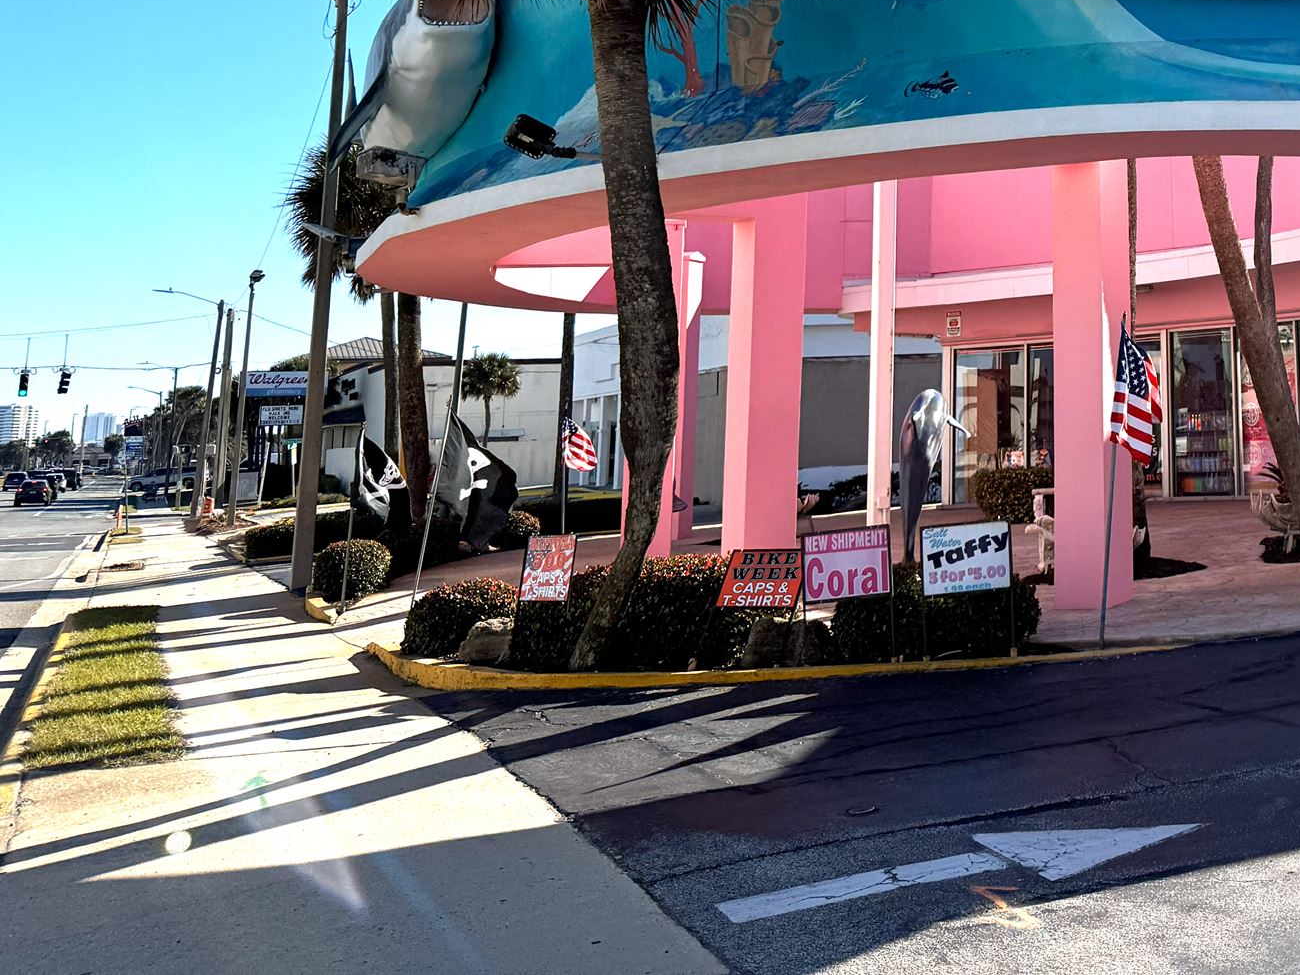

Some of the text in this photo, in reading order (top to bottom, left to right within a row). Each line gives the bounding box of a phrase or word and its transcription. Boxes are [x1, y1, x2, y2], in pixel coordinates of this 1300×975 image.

[249, 373, 308, 388] Walgree
[805, 528, 888, 552] NEW SHIPMENT!
[923, 528, 949, 540] Salt
[529, 535, 576, 551] DAYTONA
[929, 538, 961, 549] Water
[927, 531, 1009, 570] Taffy
[531, 551, 566, 569] 500
[741, 552, 798, 565] BIKE
[530, 571, 564, 584] CAPS &
[733, 566, 800, 580] WEEK
[806, 550, 889, 599] Coral
[929, 571, 938, 585] 3
[940, 570, 966, 583] for
[732, 581, 788, 594] CAPS &
[723, 594, 793, 607] T-SHIRTS
